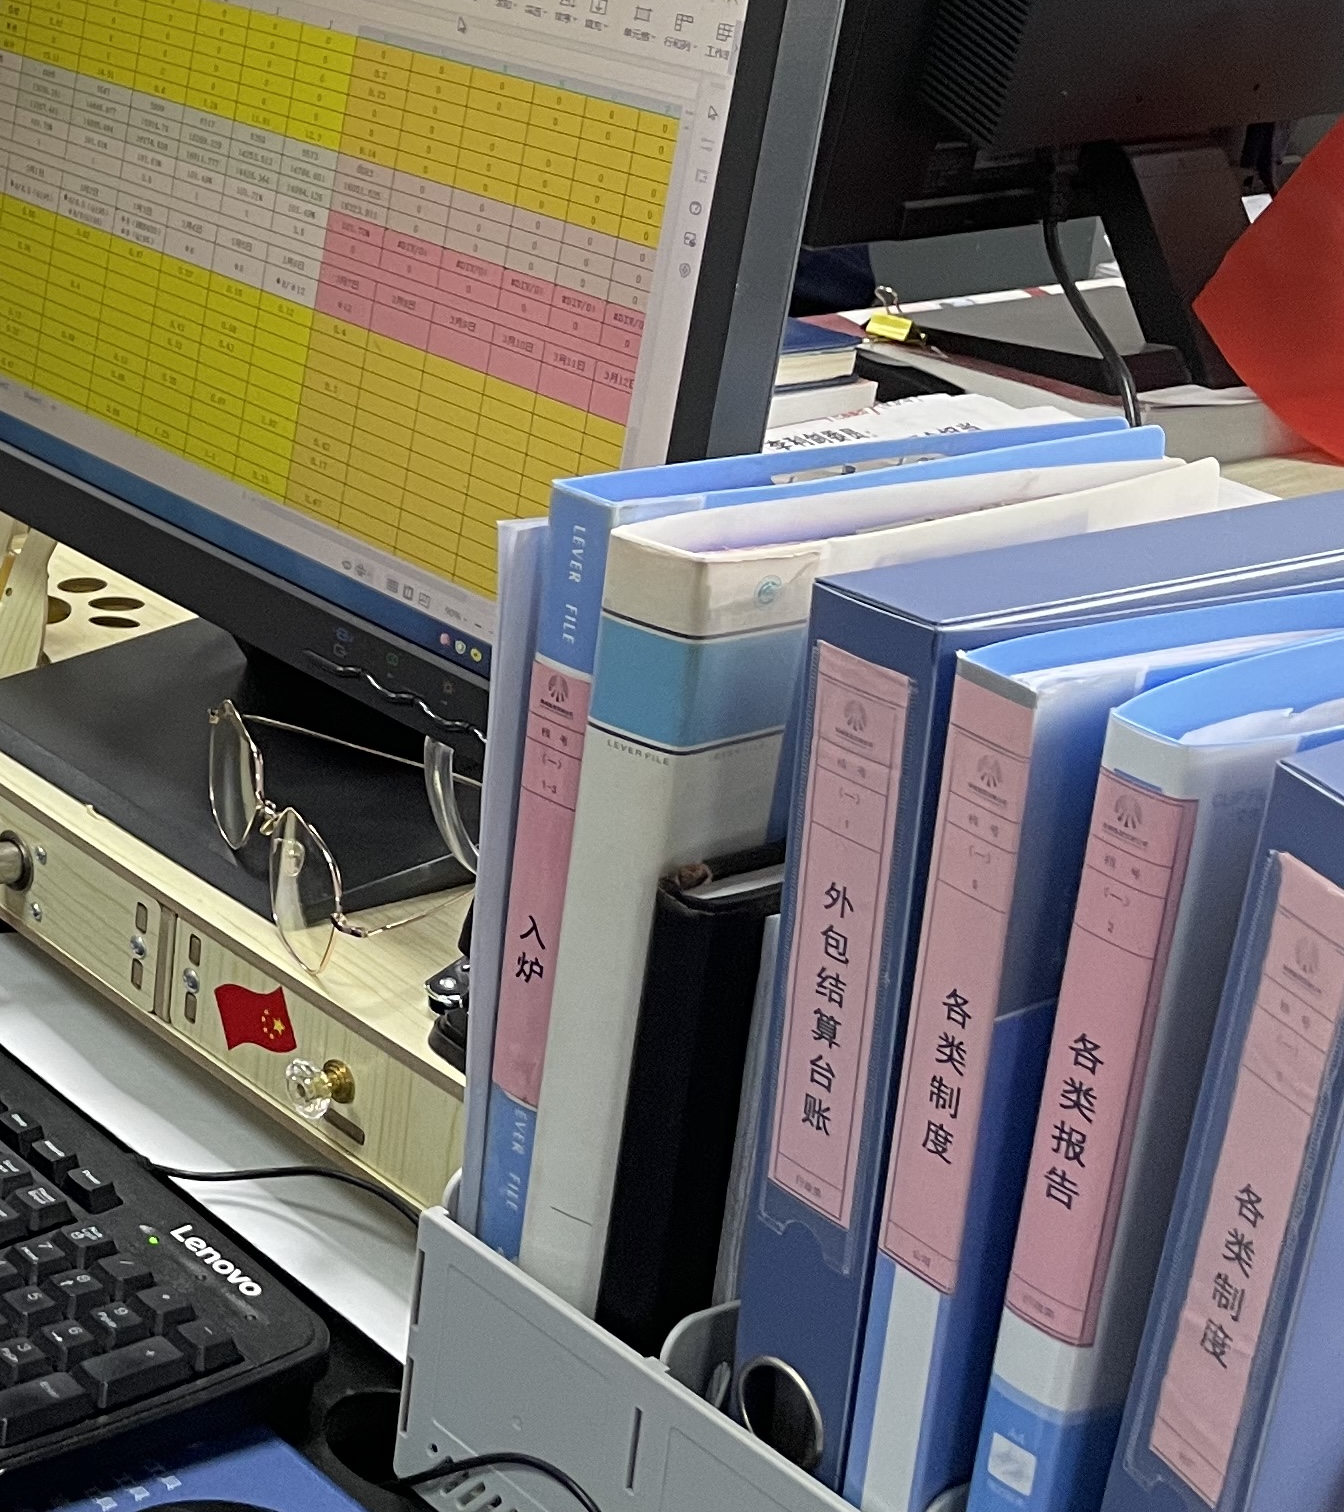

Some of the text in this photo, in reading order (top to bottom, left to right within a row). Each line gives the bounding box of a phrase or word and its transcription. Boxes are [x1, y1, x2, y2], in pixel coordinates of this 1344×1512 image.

[562, 525, 586, 645] LEVER FILE
[607, 740, 669, 766] LEVER FILE
[516, 915, 546, 983] 入炉
[802, 882, 856, 1136] 外包结算台账
[921, 988, 973, 1165] 各类制度
[1043, 1032, 1106, 1210] 各类报告
[170, 1225, 262, 1296] Lenovo
[1199, 1184, 1266, 1368] 各类制度
